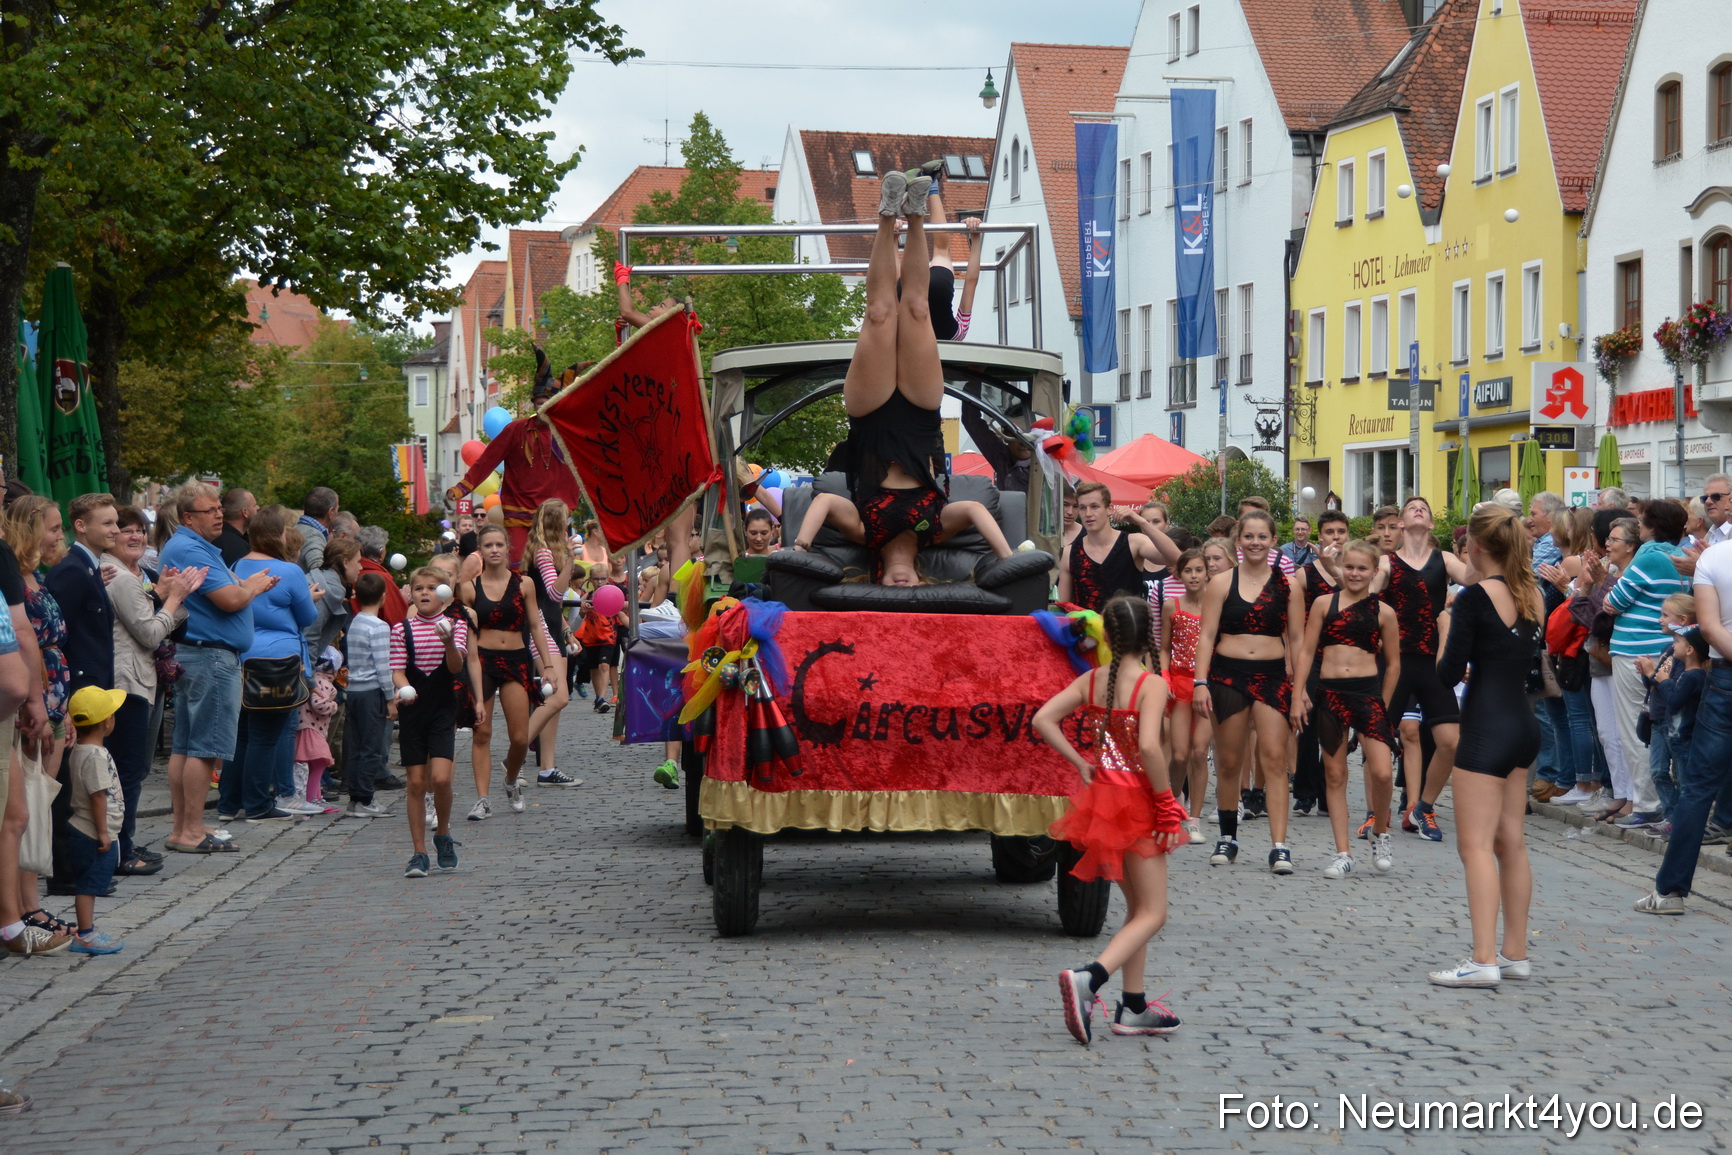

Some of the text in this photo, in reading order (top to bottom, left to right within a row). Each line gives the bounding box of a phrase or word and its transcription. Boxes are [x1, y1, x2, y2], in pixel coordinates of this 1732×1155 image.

[1181, 193, 1203, 255] K&L
[1353, 249, 1432, 290] HOTEL Lehmeier
[1411, 348, 1417, 380] P
[1391, 398, 1432, 407] TAIUN
[1461, 379, 1468, 412] P
[1472, 382, 1503, 404] TAIFUN
[1348, 413, 1395, 436] Restaurant
[1624, 448, 1645, 459] APOTHEKE
[1690, 442, 1713, 454] APOTHEKE
[460, 501, 469, 512] T
[260, 685, 294, 698] FILA
